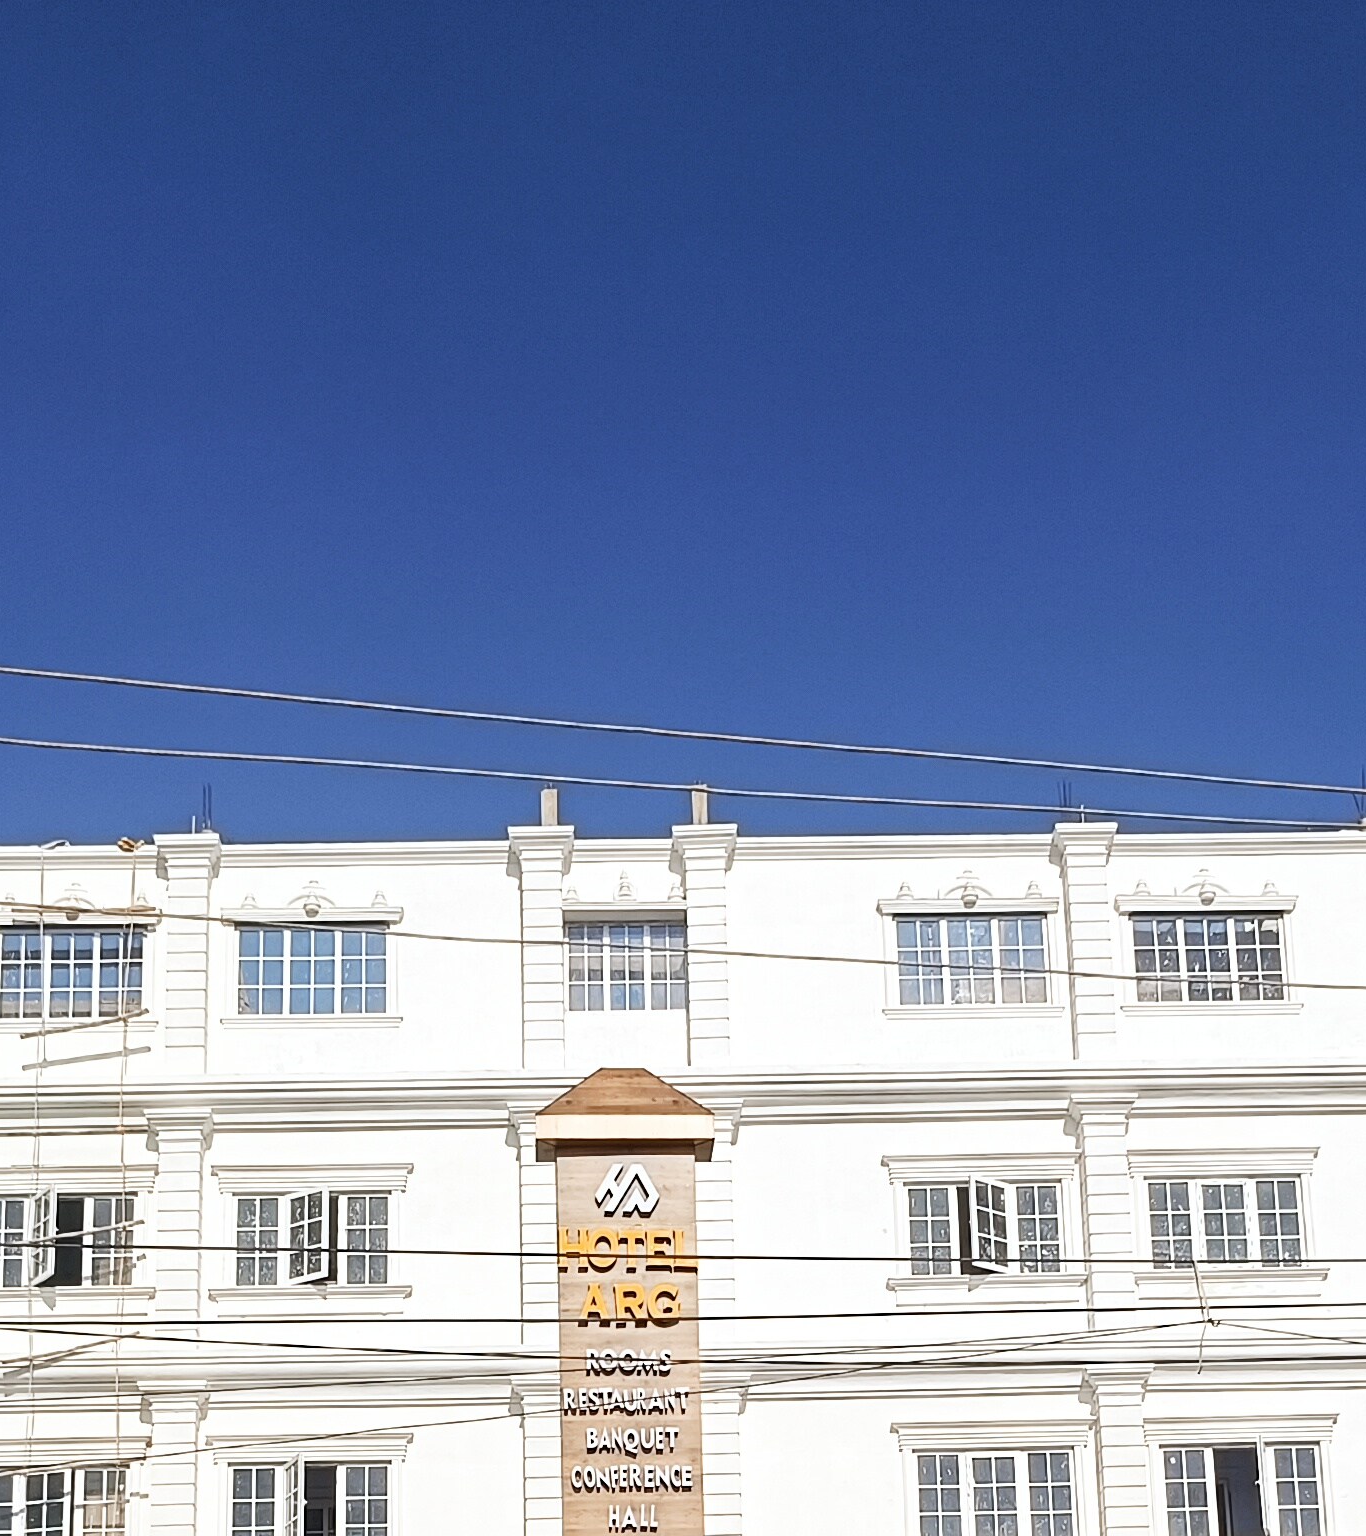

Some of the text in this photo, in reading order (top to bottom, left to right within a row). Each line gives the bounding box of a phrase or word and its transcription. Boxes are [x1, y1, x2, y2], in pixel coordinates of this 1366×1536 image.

[558, 1226, 698, 1272] HOTEL
[579, 1282, 681, 1327] ARG
[586, 1349, 672, 1376] ROOMS
[563, 1387, 689, 1415] RESTAURANT
[586, 1427, 679, 1458] BANQUET
[571, 1464, 693, 1493] CONFERENCE
[608, 1504, 658, 1532] HALL
